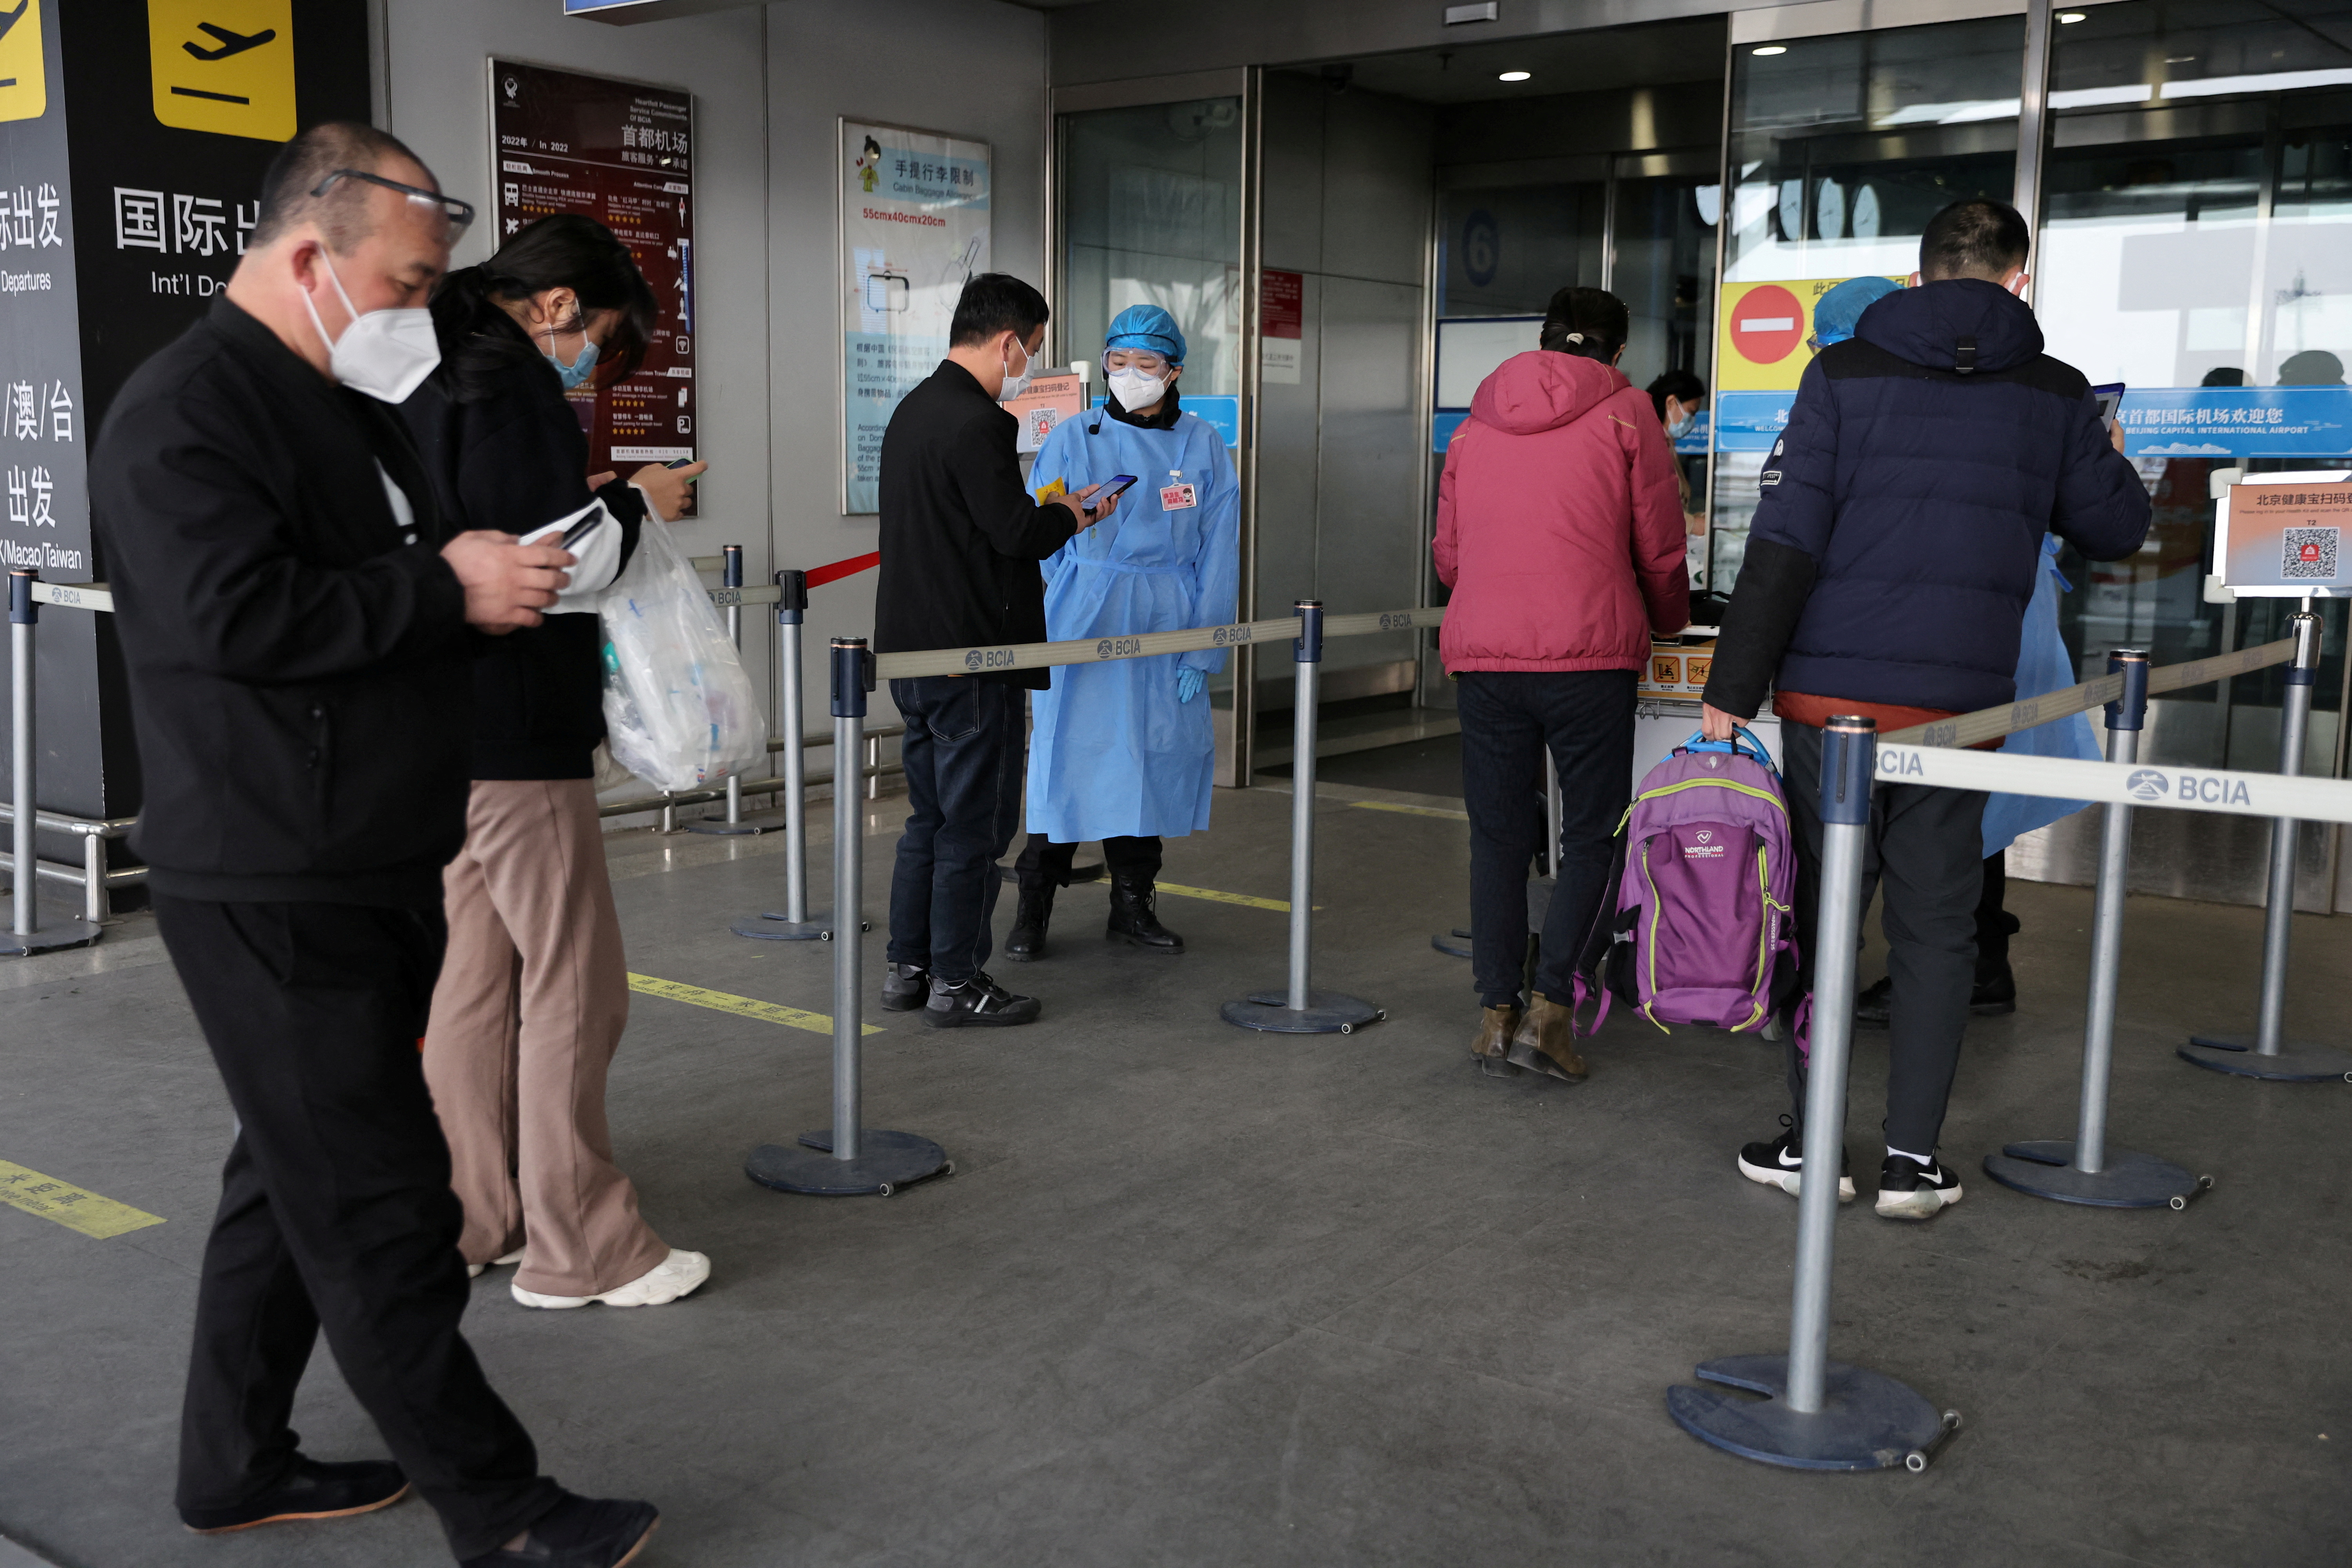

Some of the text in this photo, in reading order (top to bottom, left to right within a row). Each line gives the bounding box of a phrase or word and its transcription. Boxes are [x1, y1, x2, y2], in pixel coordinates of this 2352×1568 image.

[502, 135, 528, 148] 2022年
[539, 140, 547, 149] In
[551, 142, 568, 152] 2022
[621, 124, 687, 154] 首都机场
[895, 160, 974, 186] 手提行李限制
[893, 182, 913, 192] Cabin
[915, 185, 944, 199] Baggage
[863, 208, 946, 227] 55cmx40cmx20cm
[2, 270, 51, 297] Departures
[152, 271, 190, 295] Int'l
[1774, 408, 1789, 423] 北
[2198, 426, 2267, 435] INTERNATIONAL
[8, 465, 56, 528] 出发
[63, 590, 81, 604] BCIA
[718, 591, 741, 605] BCIA
[1393, 613, 1412, 628] BCIA
[1229, 626, 1251, 641] BCIA
[1115, 639, 1141, 656] BCIA
[986, 650, 1015, 668] BCIA
[1874, 750, 1924, 776] CIA
[2178, 775, 2250, 806] BCIA
[1684, 846, 1723, 854] NORTHLAND
